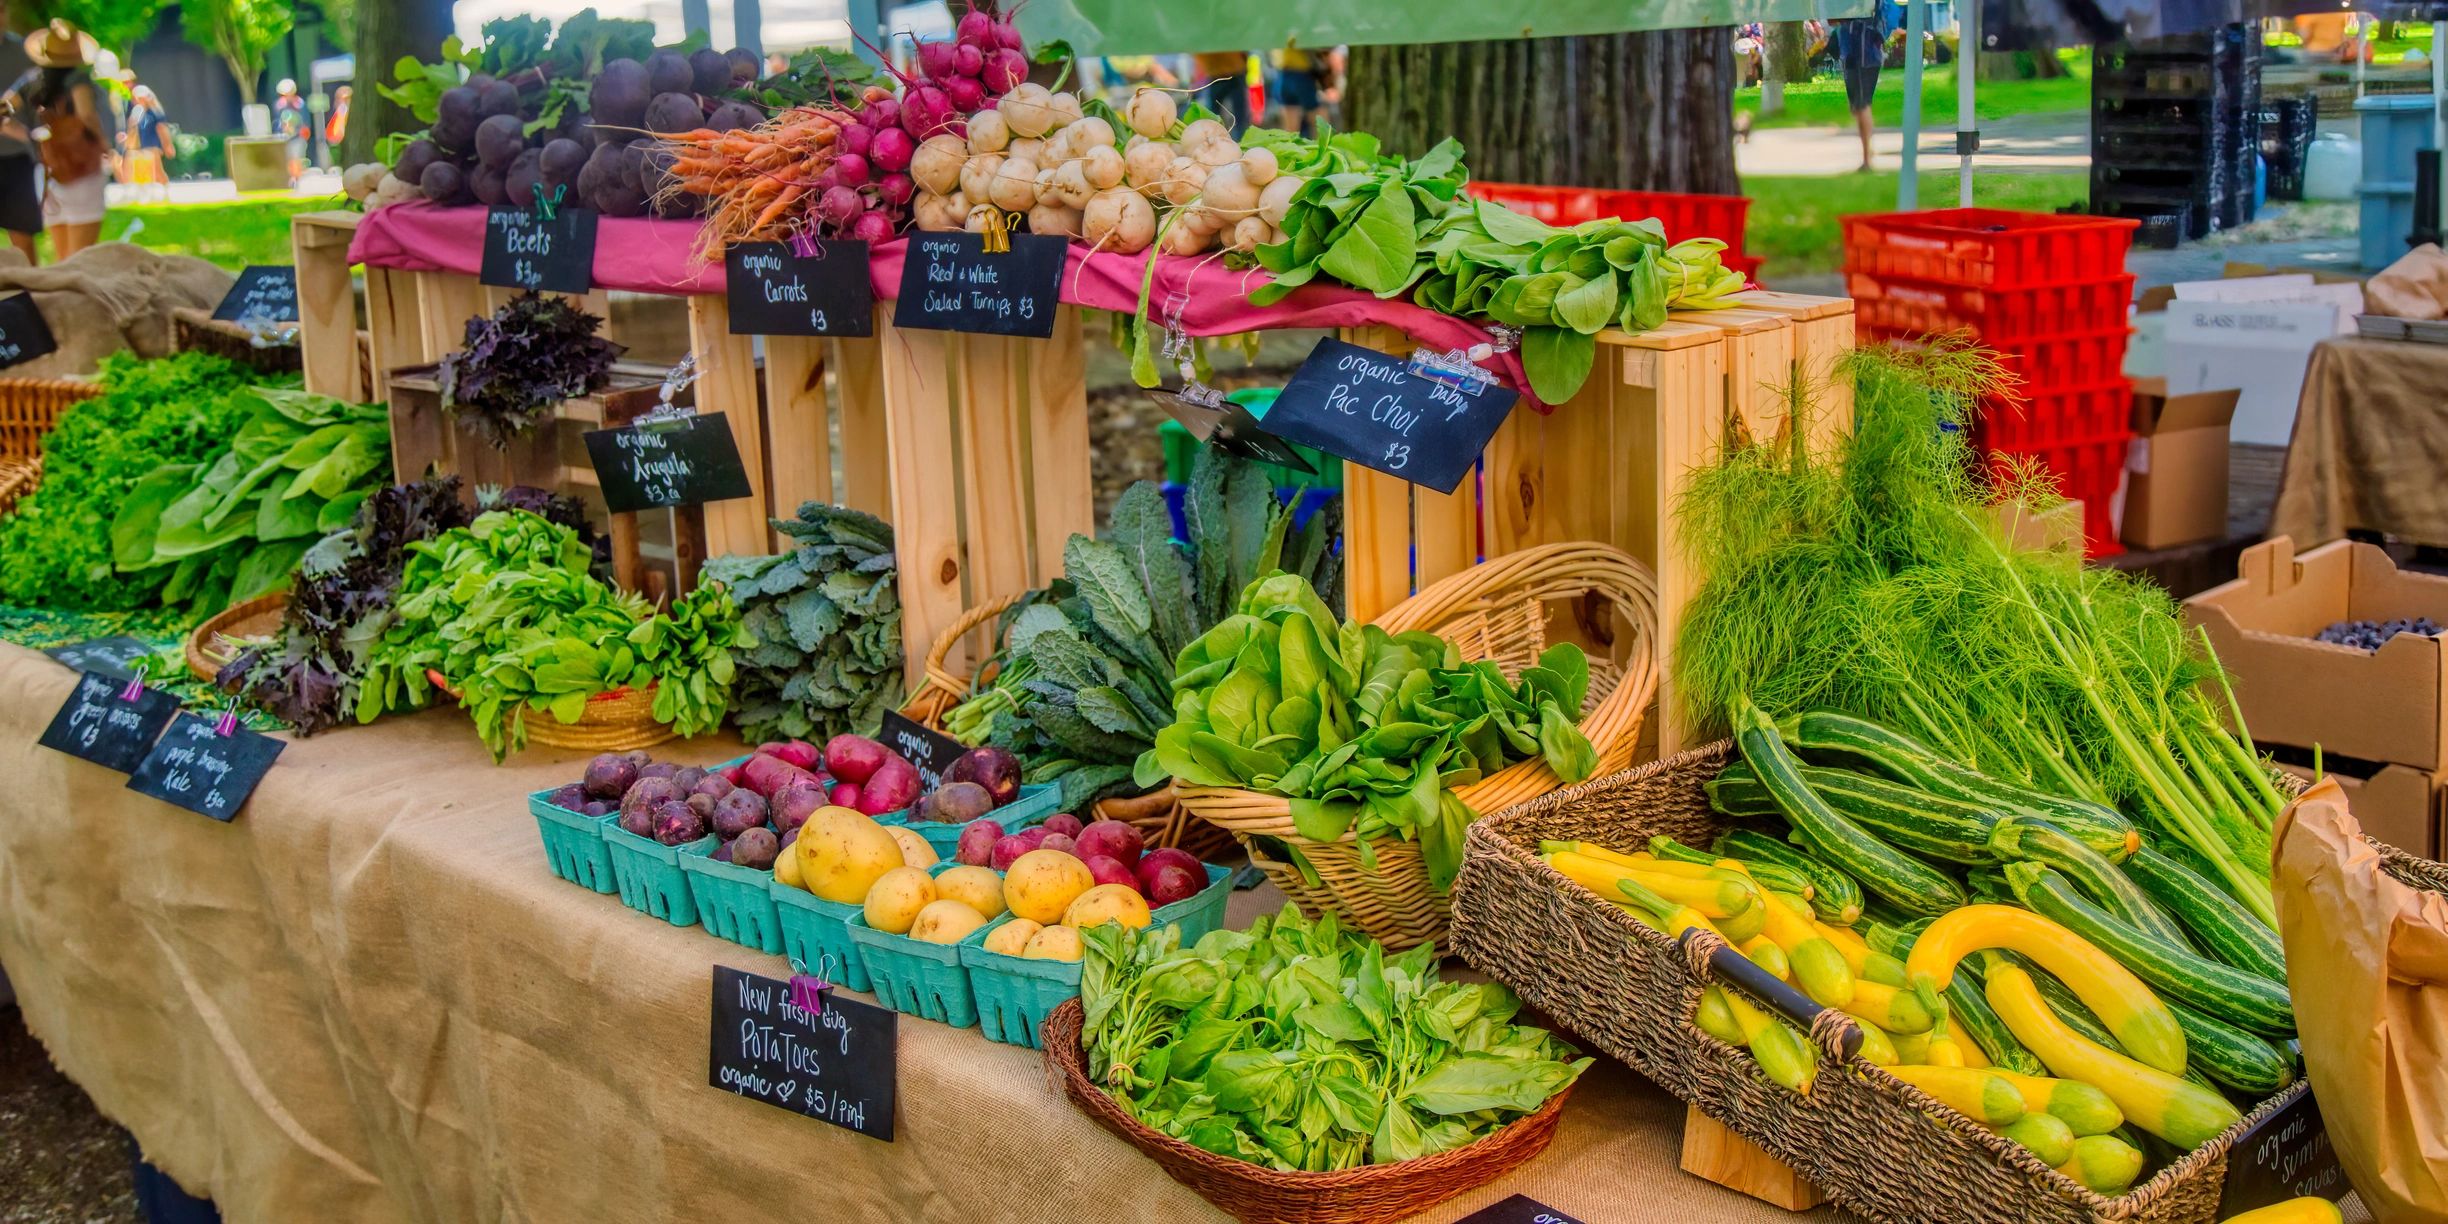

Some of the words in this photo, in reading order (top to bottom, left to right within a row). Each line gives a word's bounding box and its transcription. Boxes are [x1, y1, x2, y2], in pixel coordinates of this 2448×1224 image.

[507, 223, 551, 256] Beets
[922, 240, 960, 261] organic
[744, 247, 781, 277] organic
[928, 262, 955, 283] Red
[969, 263, 999, 284] White
[765, 274, 808, 303] Carrots
[924, 289, 962, 312] Salad
[971, 291, 1012, 318] Turnips
[1018, 296, 1034, 319] $3
[811, 308, 827, 331] $3
[1338, 355, 1407, 385] organic
[1325, 383, 1360, 415] Pac
[1371, 395, 1425, 437] Choi
[1428, 376, 1469, 421] baby
[616, 432, 667, 457] organic
[1384, 442, 1411, 469] $3
[634, 452, 692, 487] Arugula
[898, 730, 932, 758] organic
[739, 976, 771, 1015] New
[823, 1003, 852, 1055] dug
[720, 1064, 772, 1095] organic
[2257, 1113, 2307, 1170] organic
